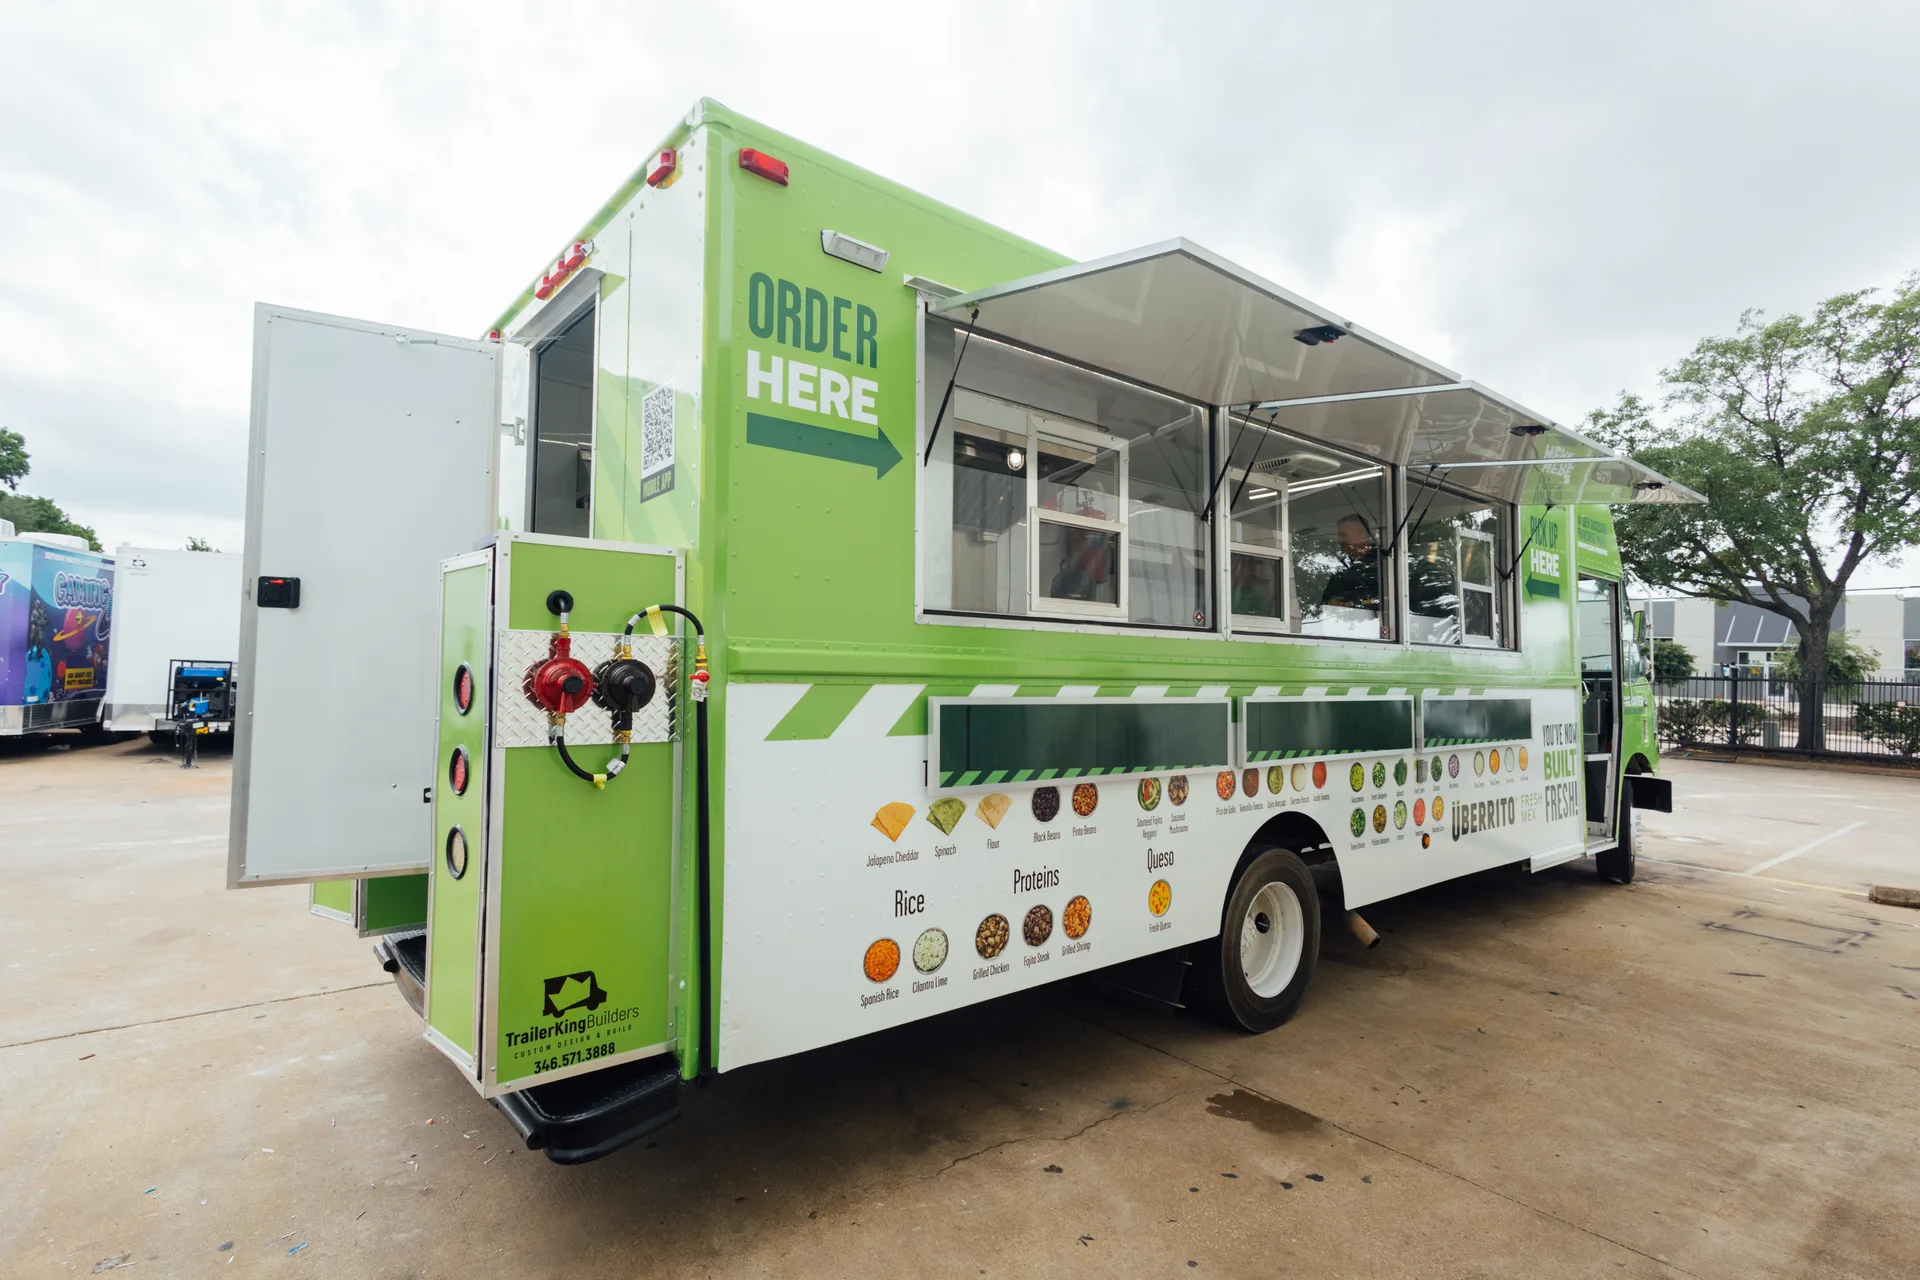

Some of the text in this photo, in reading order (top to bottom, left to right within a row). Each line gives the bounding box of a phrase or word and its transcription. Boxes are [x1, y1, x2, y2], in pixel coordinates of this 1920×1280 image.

[749, 272, 877, 368] ORDER
[747, 349, 878, 425] HERE
[661, 470, 672, 491] APP
[1530, 515, 1547, 547] PICK
[1549, 520, 1558, 549] UP
[1531, 547, 1559, 577] HERE
[54, 570, 110, 609] GAMING
[1542, 724, 1562, 746] YOU'VE
[1543, 749, 1576, 780] BUILT
[1520, 792, 1542, 808] FRESH
[1545, 781, 1578, 823] FRESH!
[1452, 796, 1515, 841] ÜBERRITO
[1521, 808, 1536, 823] MEX
[1033, 830, 1061, 842] Black Beans
[1072, 825, 1096, 836] Pinto Beans
[1142, 830, 1157, 840] Veggies
[934, 844, 956, 860] Spinach
[987, 838, 1000, 850] Flour
[866, 850, 919, 868] Jalapeno Cheddar
[1148, 848, 1174, 873] Queso
[1014, 865, 1059, 894] Proteins
[894, 890, 925, 918] Rice
[1149, 920, 1171, 933] Fresh Queso
[1062, 940, 1091, 956] Grilled Shrimp
[1024, 951, 1050, 968] Fajita Steak
[972, 962, 1010, 980] Grilled Chicken
[912, 976, 948, 994] Cilantro Lime
[860, 988, 900, 1008] Spanish Rice
[506, 1006, 639, 1047] TrailerKingBuilders
[514, 1044, 551, 1059] CUSTOM
[558, 1036, 591, 1048] DESIGN
[606, 1024, 632, 1036] BUILD
[534, 1042, 616, 1074] 346.571.3888
